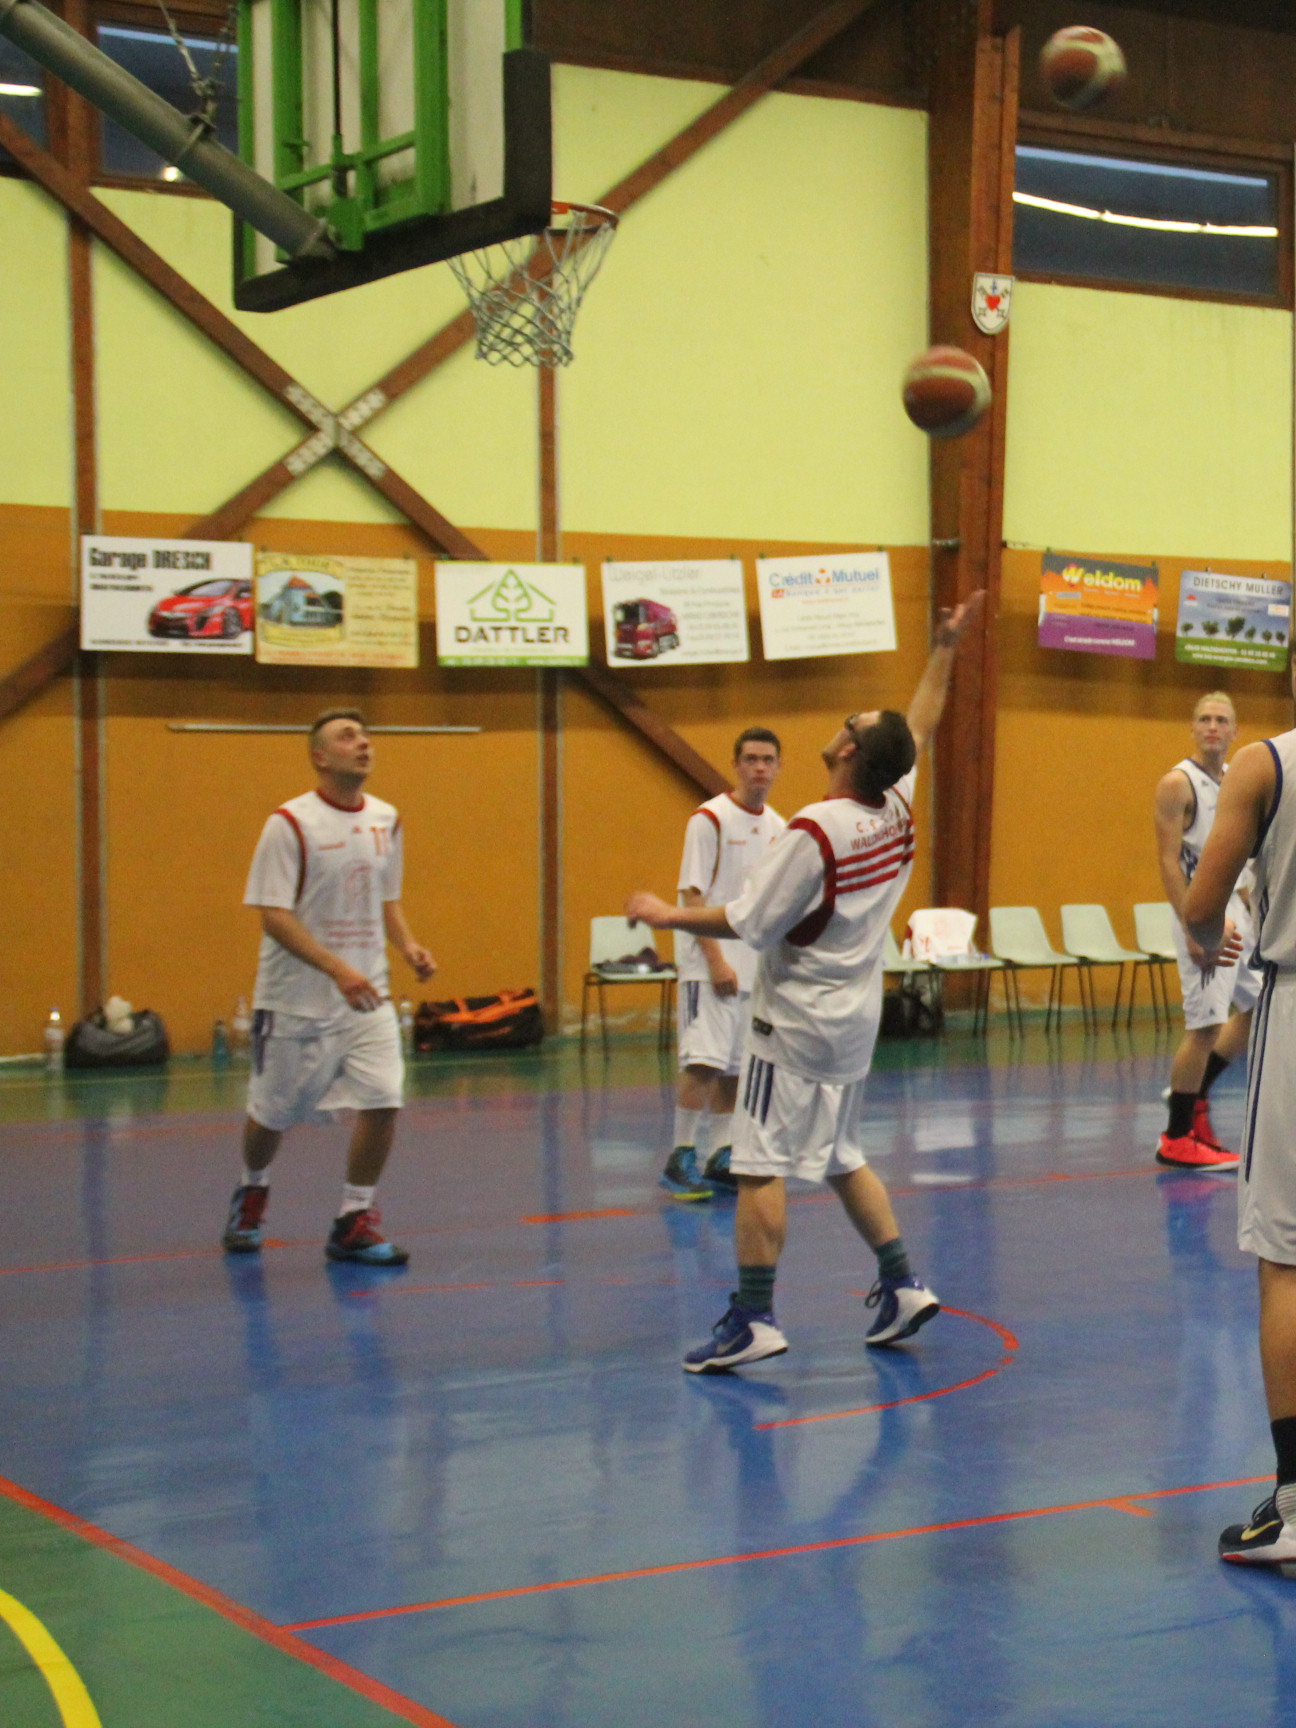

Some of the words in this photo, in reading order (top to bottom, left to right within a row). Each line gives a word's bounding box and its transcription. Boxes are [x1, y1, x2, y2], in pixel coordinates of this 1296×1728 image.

[89, 547, 148, 571] Garage
[768, 572, 813, 587] Crédit
[831, 567, 880, 584] Mutuel
[1062, 566, 1142, 591] Weldom
[454, 625, 570, 643] DATTLER
